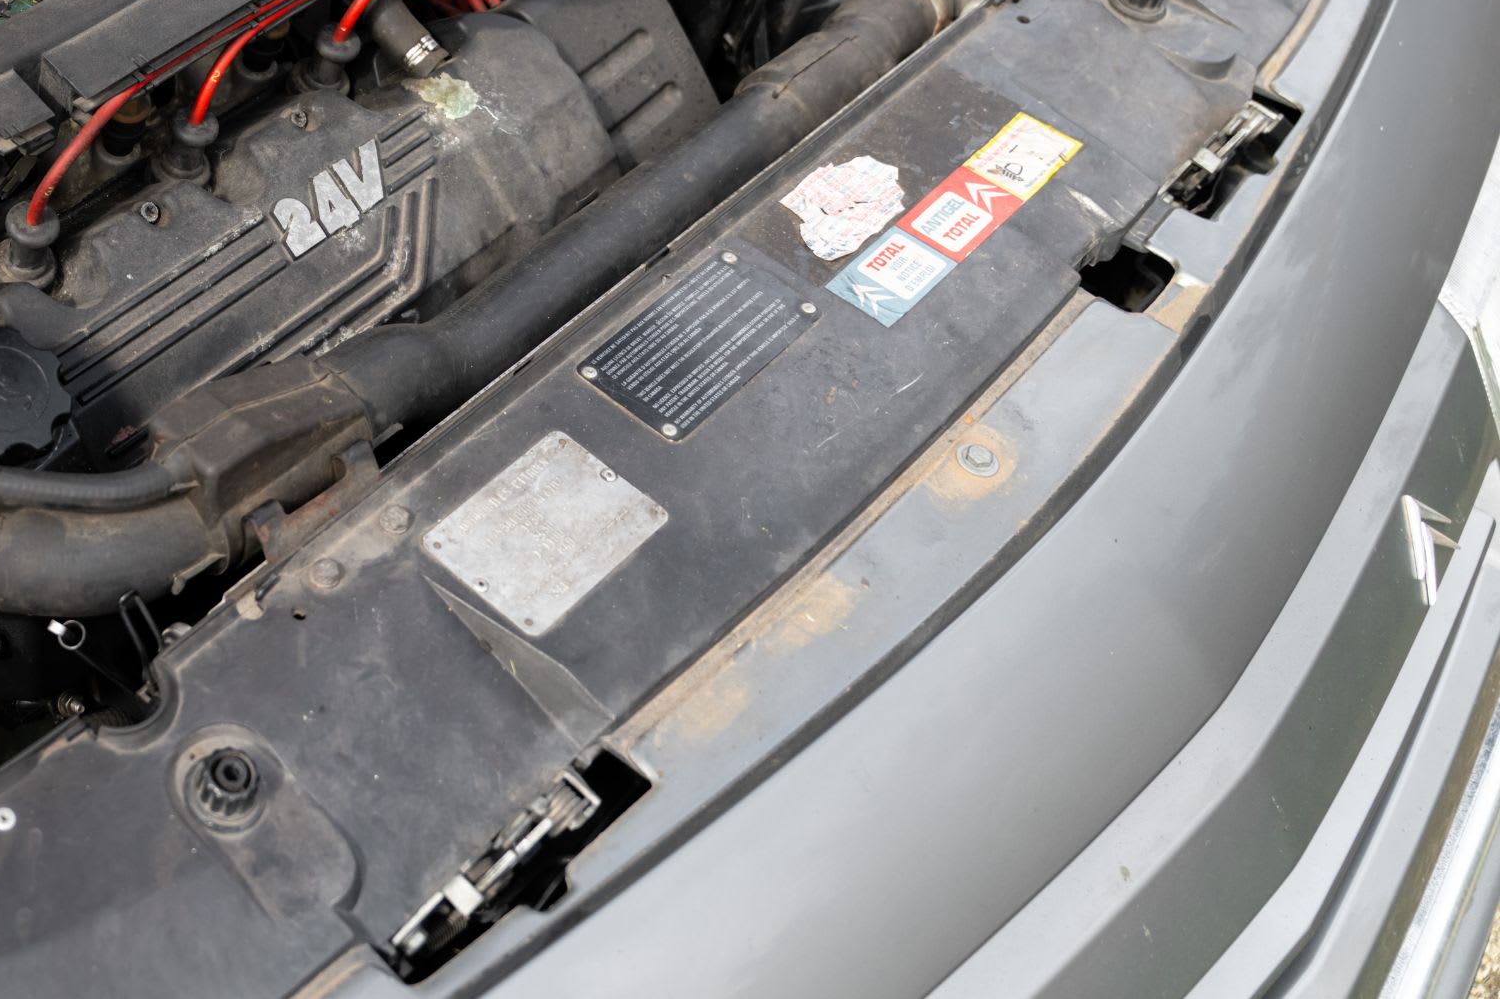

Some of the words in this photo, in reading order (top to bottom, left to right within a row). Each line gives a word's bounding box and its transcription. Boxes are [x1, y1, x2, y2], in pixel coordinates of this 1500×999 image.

[209, 70, 221, 82] 2
[273, 138, 385, 259] 24V
[920, 198, 965, 236] ANTIGEL
[942, 212, 981, 242] TOTAL
[865, 242, 906, 272] TOTAL
[890, 256, 909, 272] VOIR
[897, 259, 921, 283] NOTICE
